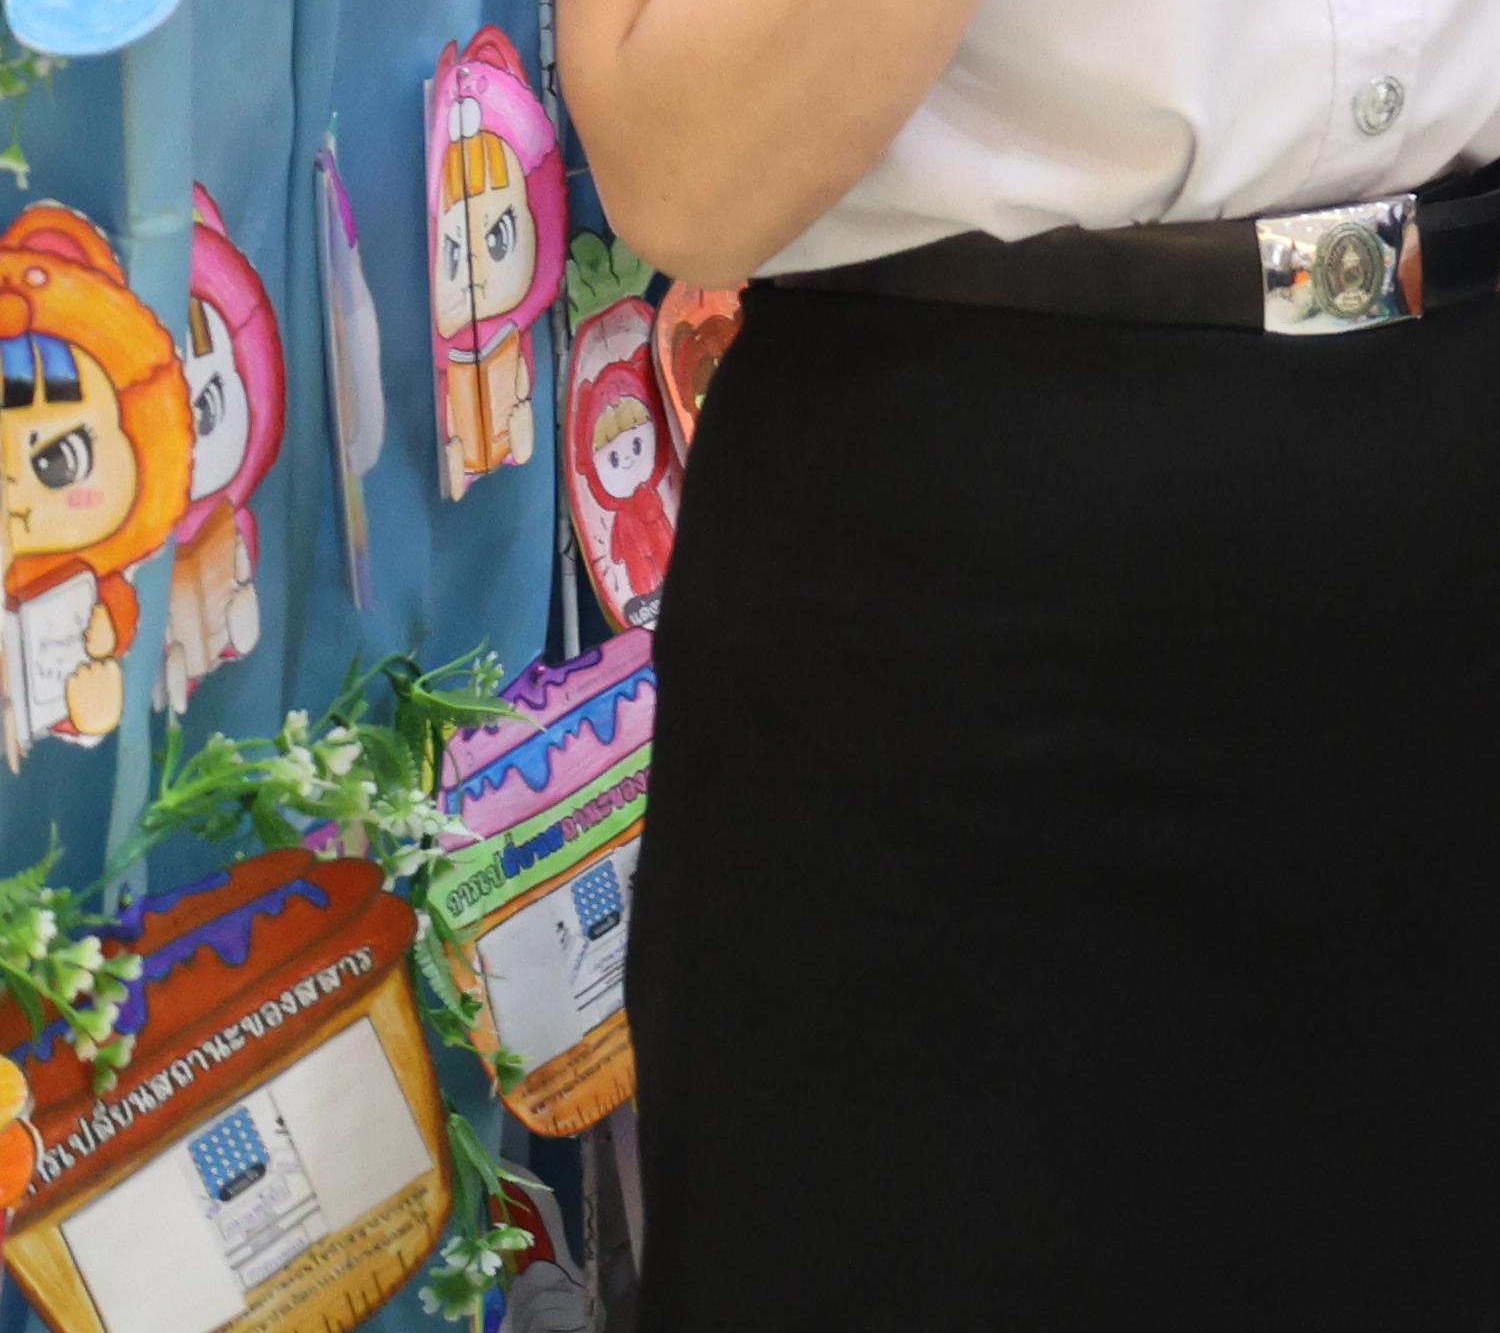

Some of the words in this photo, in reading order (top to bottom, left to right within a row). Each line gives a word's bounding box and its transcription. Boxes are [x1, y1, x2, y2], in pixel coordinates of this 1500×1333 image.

[28, 946, 374, 1193] รเปลี่ยนสถานะของสสาร
